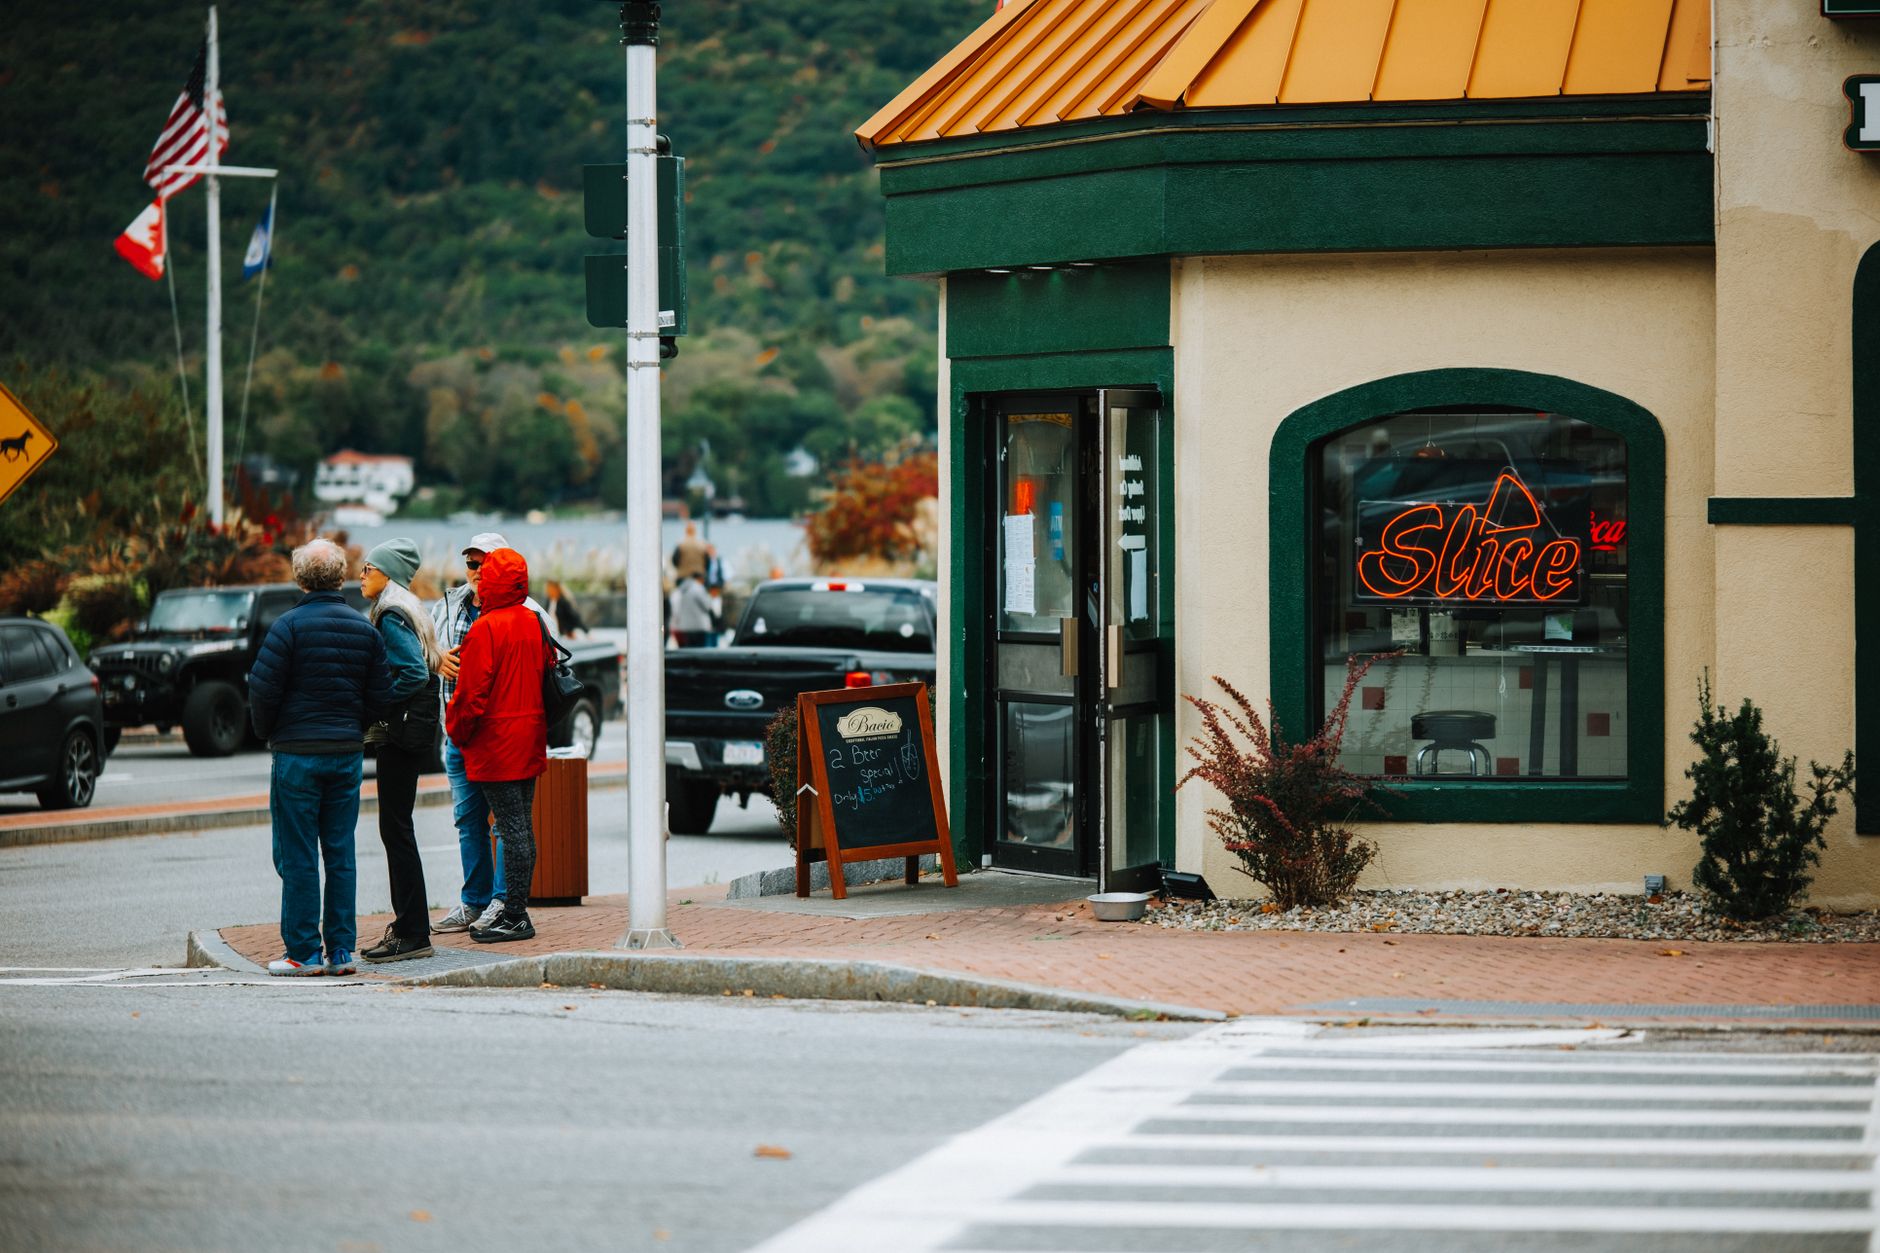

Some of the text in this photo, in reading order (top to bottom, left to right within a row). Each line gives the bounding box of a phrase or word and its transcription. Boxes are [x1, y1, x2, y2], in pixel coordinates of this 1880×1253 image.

[1358, 503, 1580, 600] Slice
[848, 713, 895, 733] Bacio
[829, 744, 882, 769] 2 Beer
[833, 790, 859, 810] Only
